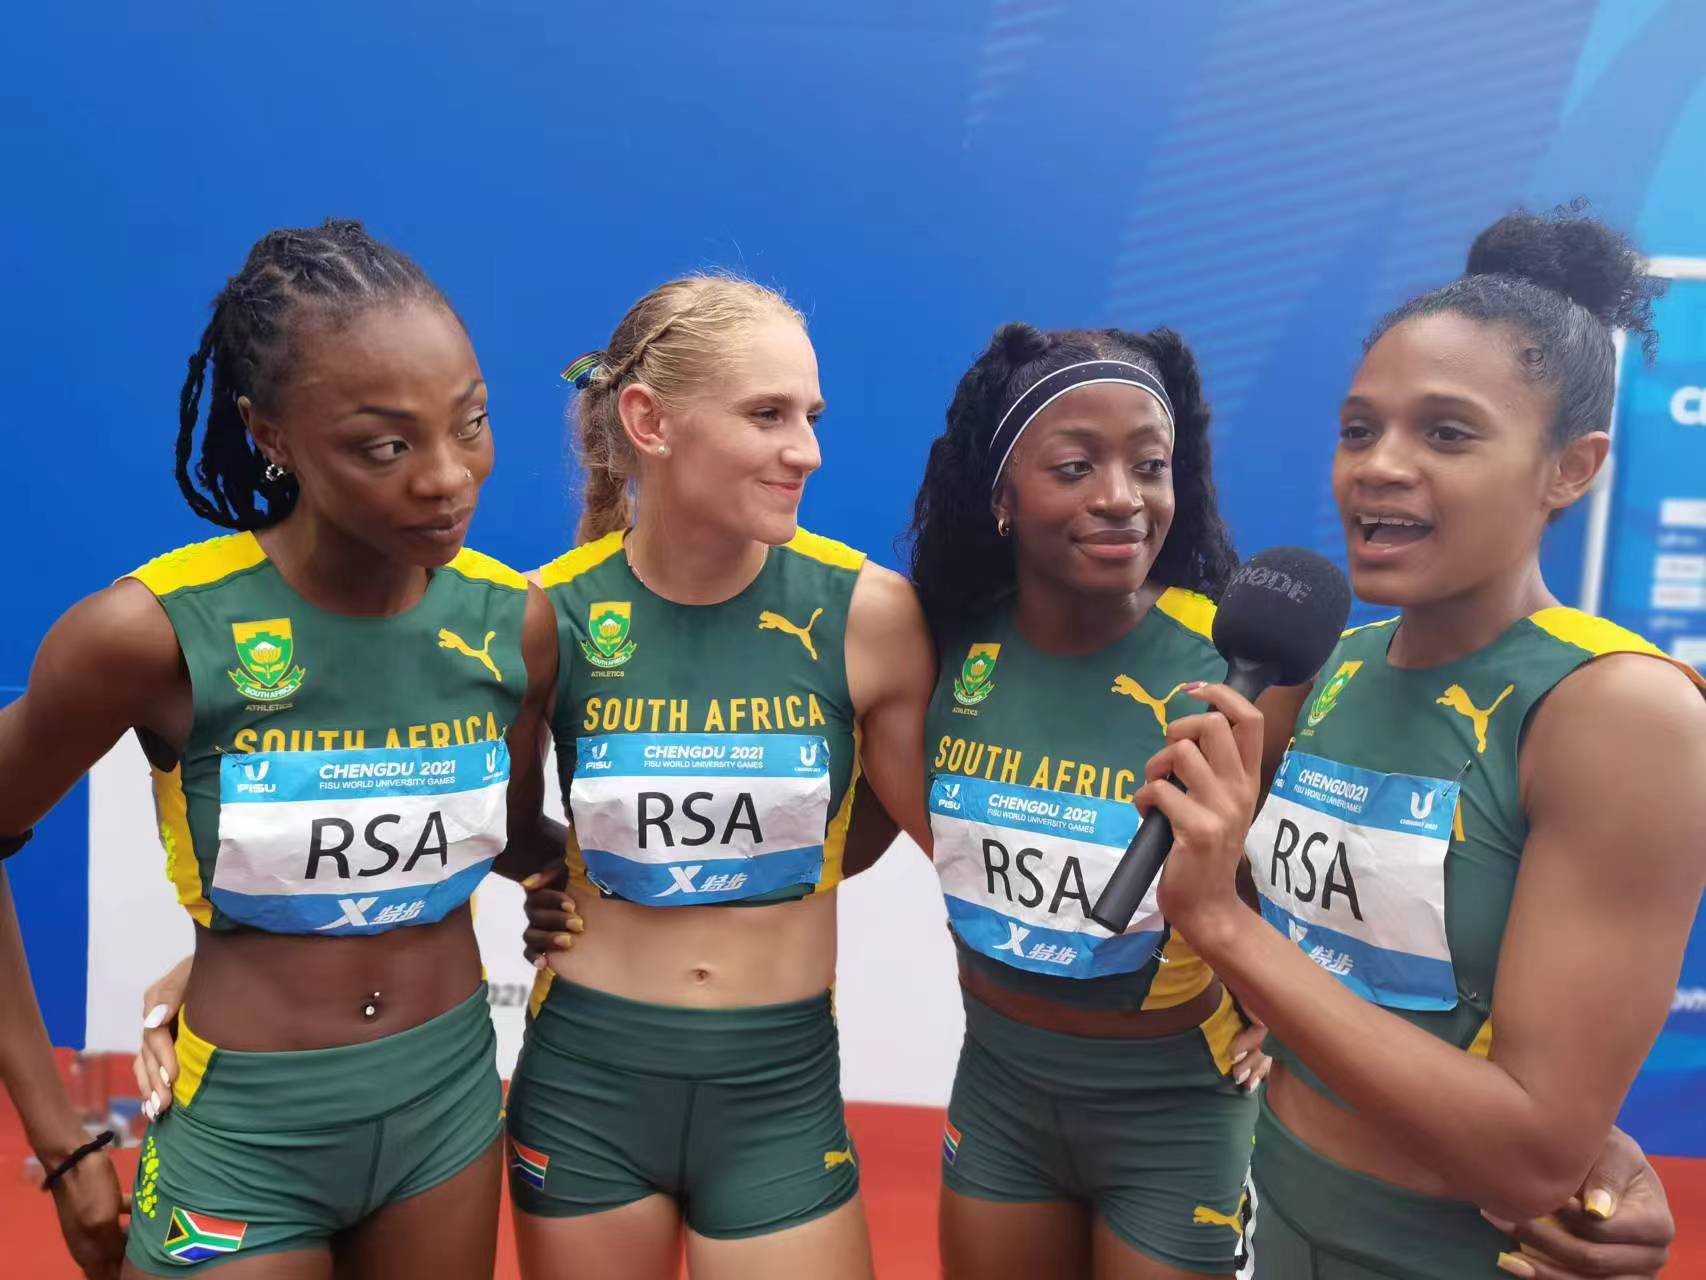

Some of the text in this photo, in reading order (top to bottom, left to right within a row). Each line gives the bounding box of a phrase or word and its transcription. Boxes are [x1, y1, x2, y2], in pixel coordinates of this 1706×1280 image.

[591, 670, 625, 678] ATHLETICS
[244, 684, 295, 699] SOUTH AFRICA
[244, 702, 293, 712] ATHLETICS
[583, 693, 827, 732] SOUTH AFRICA
[234, 711, 498, 754] SOUTH AFRICA
[643, 745, 764, 760] CHENGDU 2021
[319, 759, 456, 779] CHENGDU 2021
[586, 760, 614, 770] FISU
[643, 760, 764, 769] FISU WORLD UNIVERSITY GAMES
[934, 735, 1136, 804] SOUTH AFRIC
[237, 782, 277, 794] FISU
[319, 776, 456, 790] FISU WORLD UNIVERSITY GAMES
[939, 798, 961, 811] FISU
[1304, 787, 1327, 802] WORLD
[988, 793, 1098, 825] CHENGDU 2021
[637, 791, 764, 849] RSA
[987, 808, 1095, 834] FISU WORLD UNIVERSITY GAMES
[304, 810, 448, 880] RSA
[982, 838, 1093, 919] RSA
[1271, 818, 1364, 922] RSA
[697, 872, 749, 893] 特步
[368, 899, 426, 926] 特步
[1025, 943, 1078, 966] 特步
